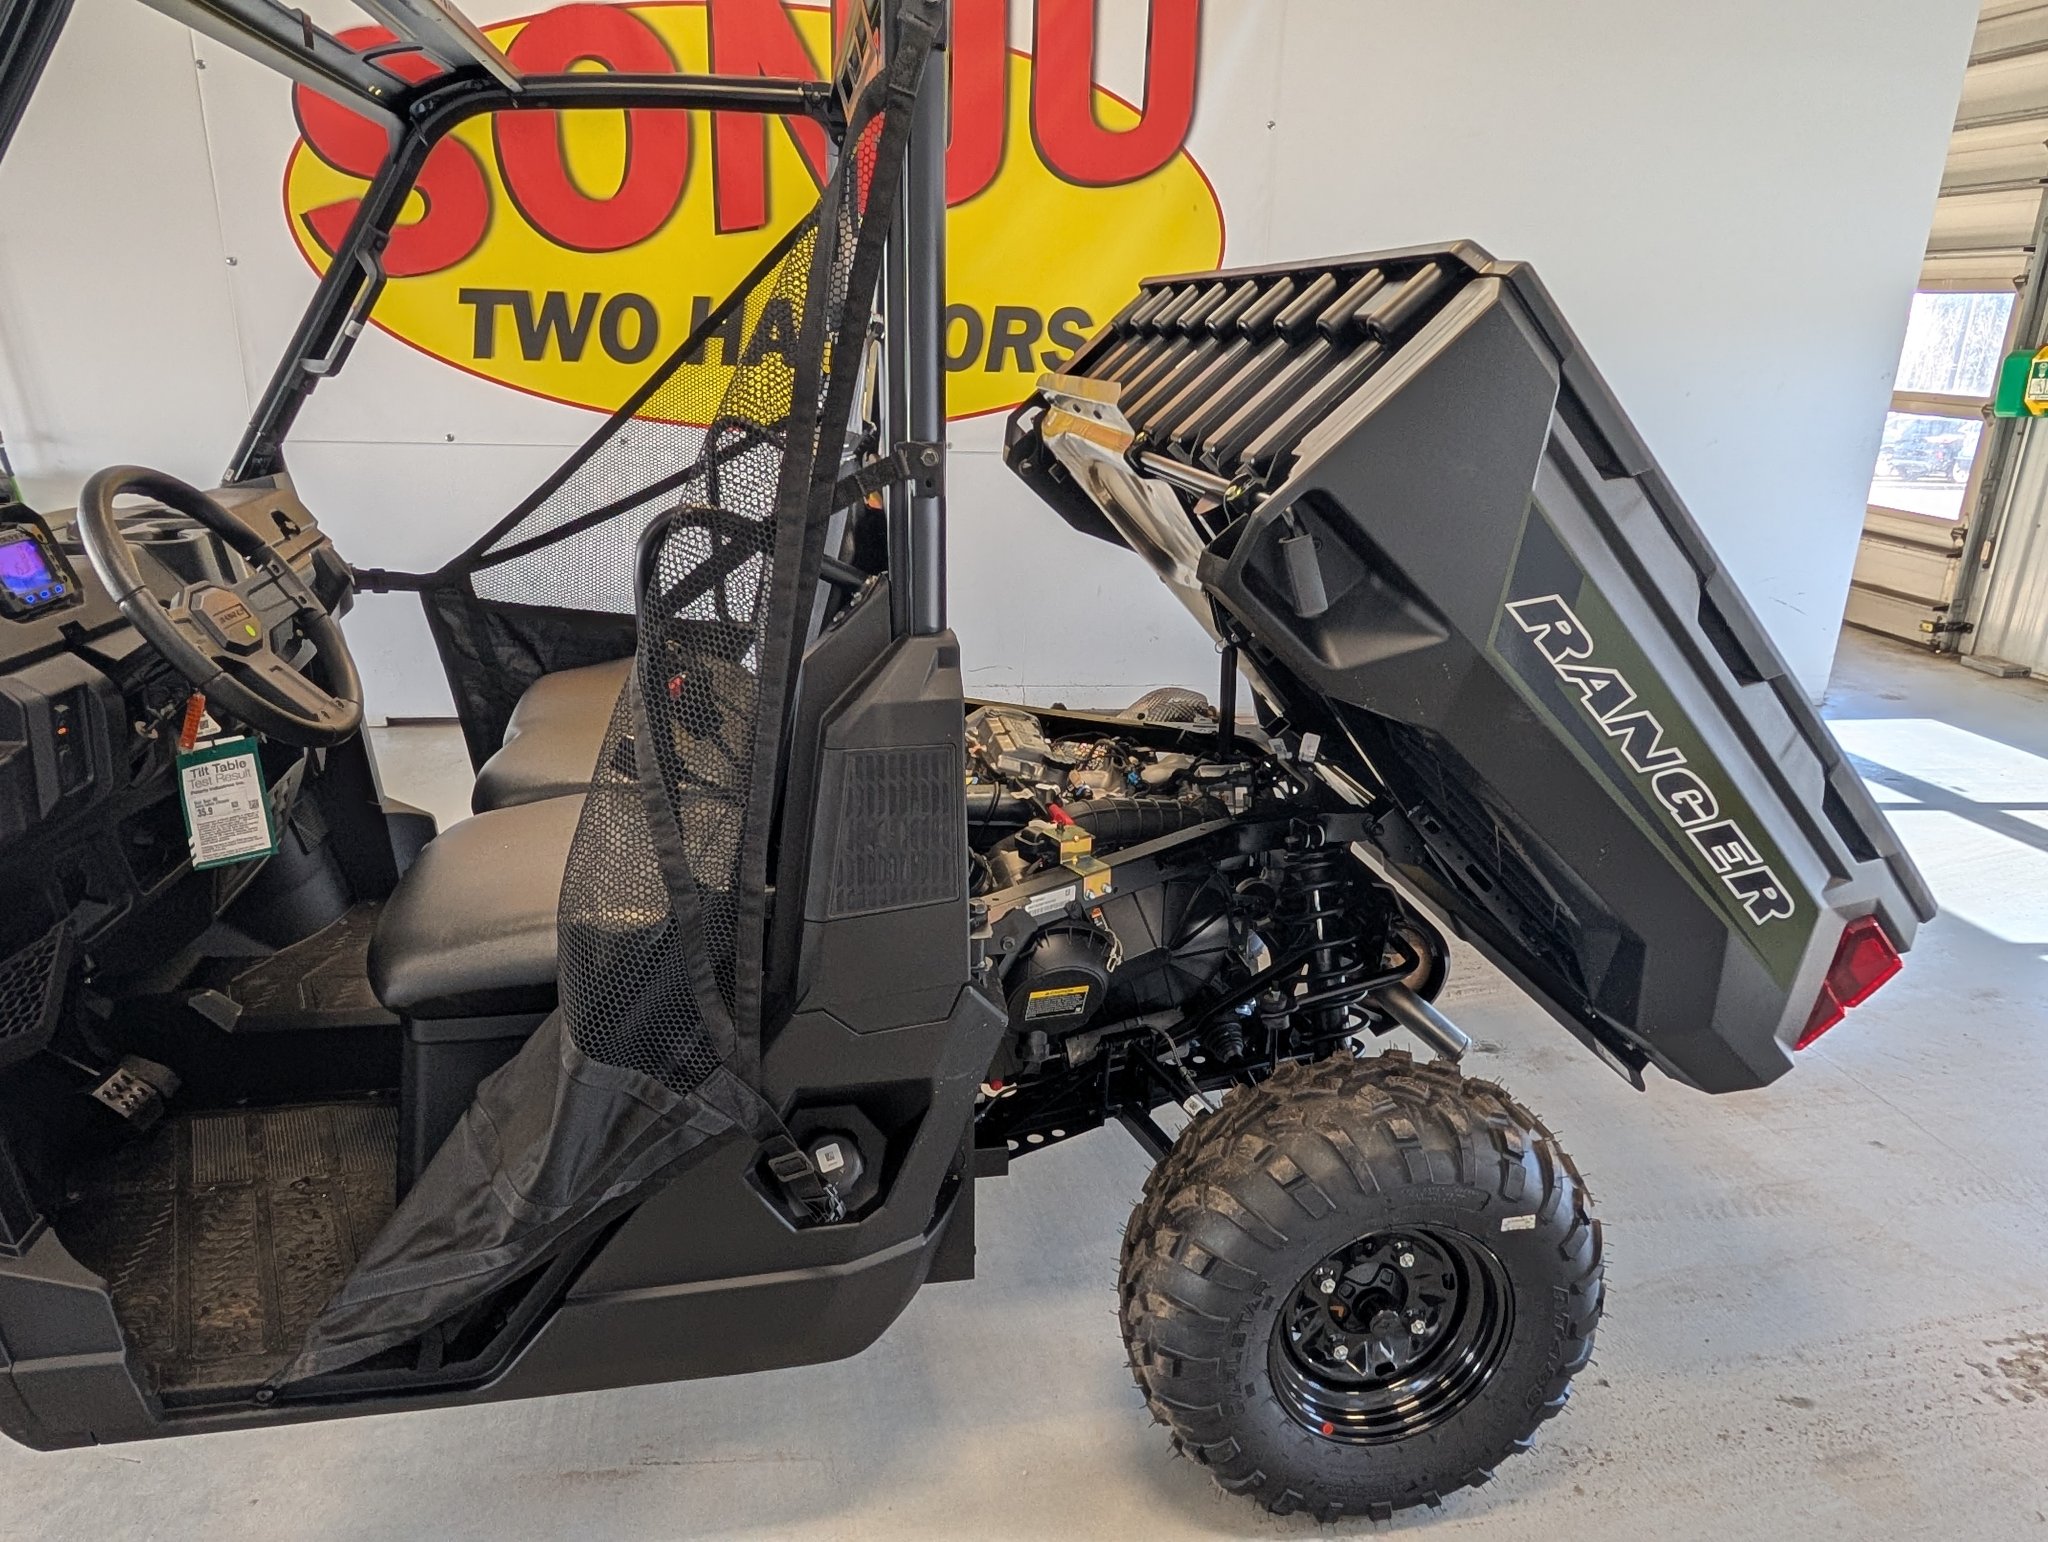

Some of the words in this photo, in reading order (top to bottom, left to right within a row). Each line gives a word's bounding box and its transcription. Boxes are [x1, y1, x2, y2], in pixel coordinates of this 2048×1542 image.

[459, 288, 659, 364] TWO
[190, 766, 209, 779] Tilt
[212, 759, 247, 773] Table
[1505, 594, 1795, 926] RANGER
[188, 776, 213, 789] Test
[215, 769, 252, 784] Result
[197, 807, 214, 817] 35.9
